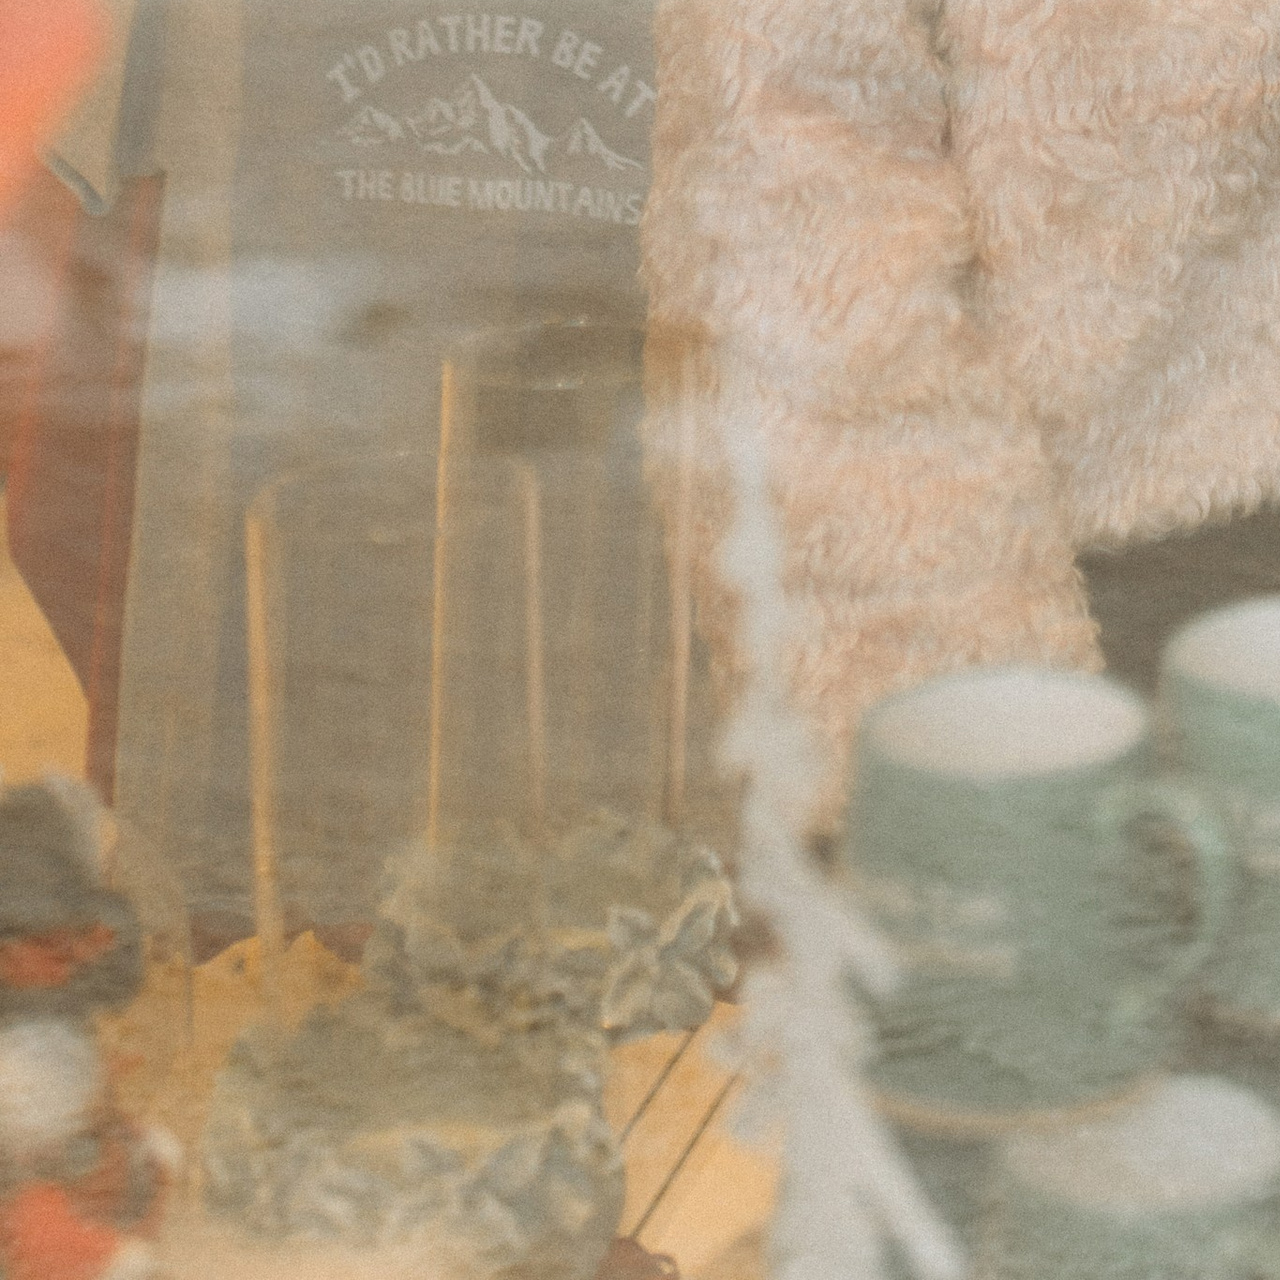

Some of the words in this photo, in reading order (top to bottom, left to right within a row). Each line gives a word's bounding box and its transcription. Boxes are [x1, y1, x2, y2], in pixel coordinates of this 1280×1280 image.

[327, 44, 387, 104] I'D
[387, 12, 545, 66] RATHER
[551, 29, 604, 81] BE
[596, 63, 658, 119] AT
[336, 169, 395, 201] THE
[401, 171, 461, 208] BLUE
[467, 175, 646, 226] MOUNTAINS
